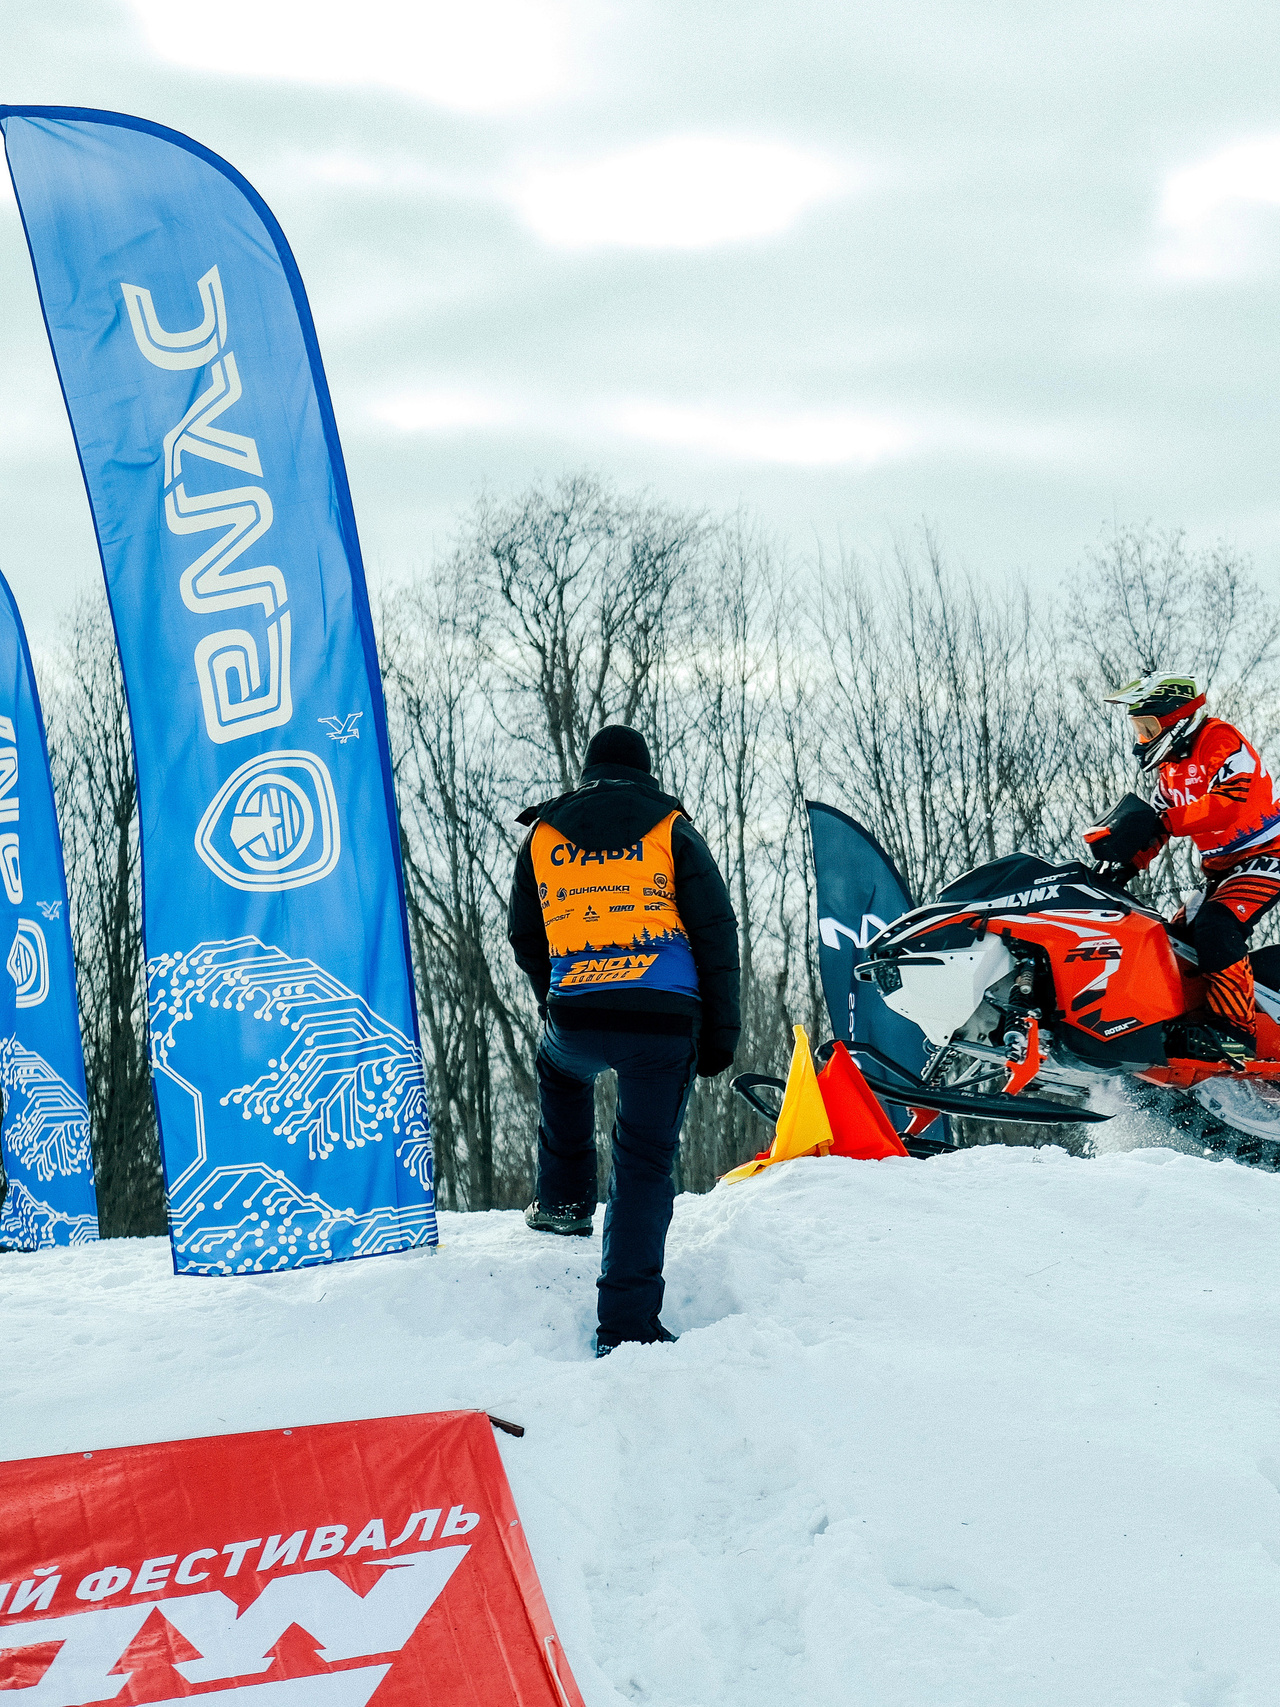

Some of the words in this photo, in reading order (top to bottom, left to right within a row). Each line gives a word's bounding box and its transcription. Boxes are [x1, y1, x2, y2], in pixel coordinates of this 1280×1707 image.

[550, 841, 643, 867] СУДЬЯ
[1006, 884, 1061, 907] LYNX
[1064, 945, 1123, 963] RS
[75, 1504, 481, 1603] ФЕСТИВАЛЬ
